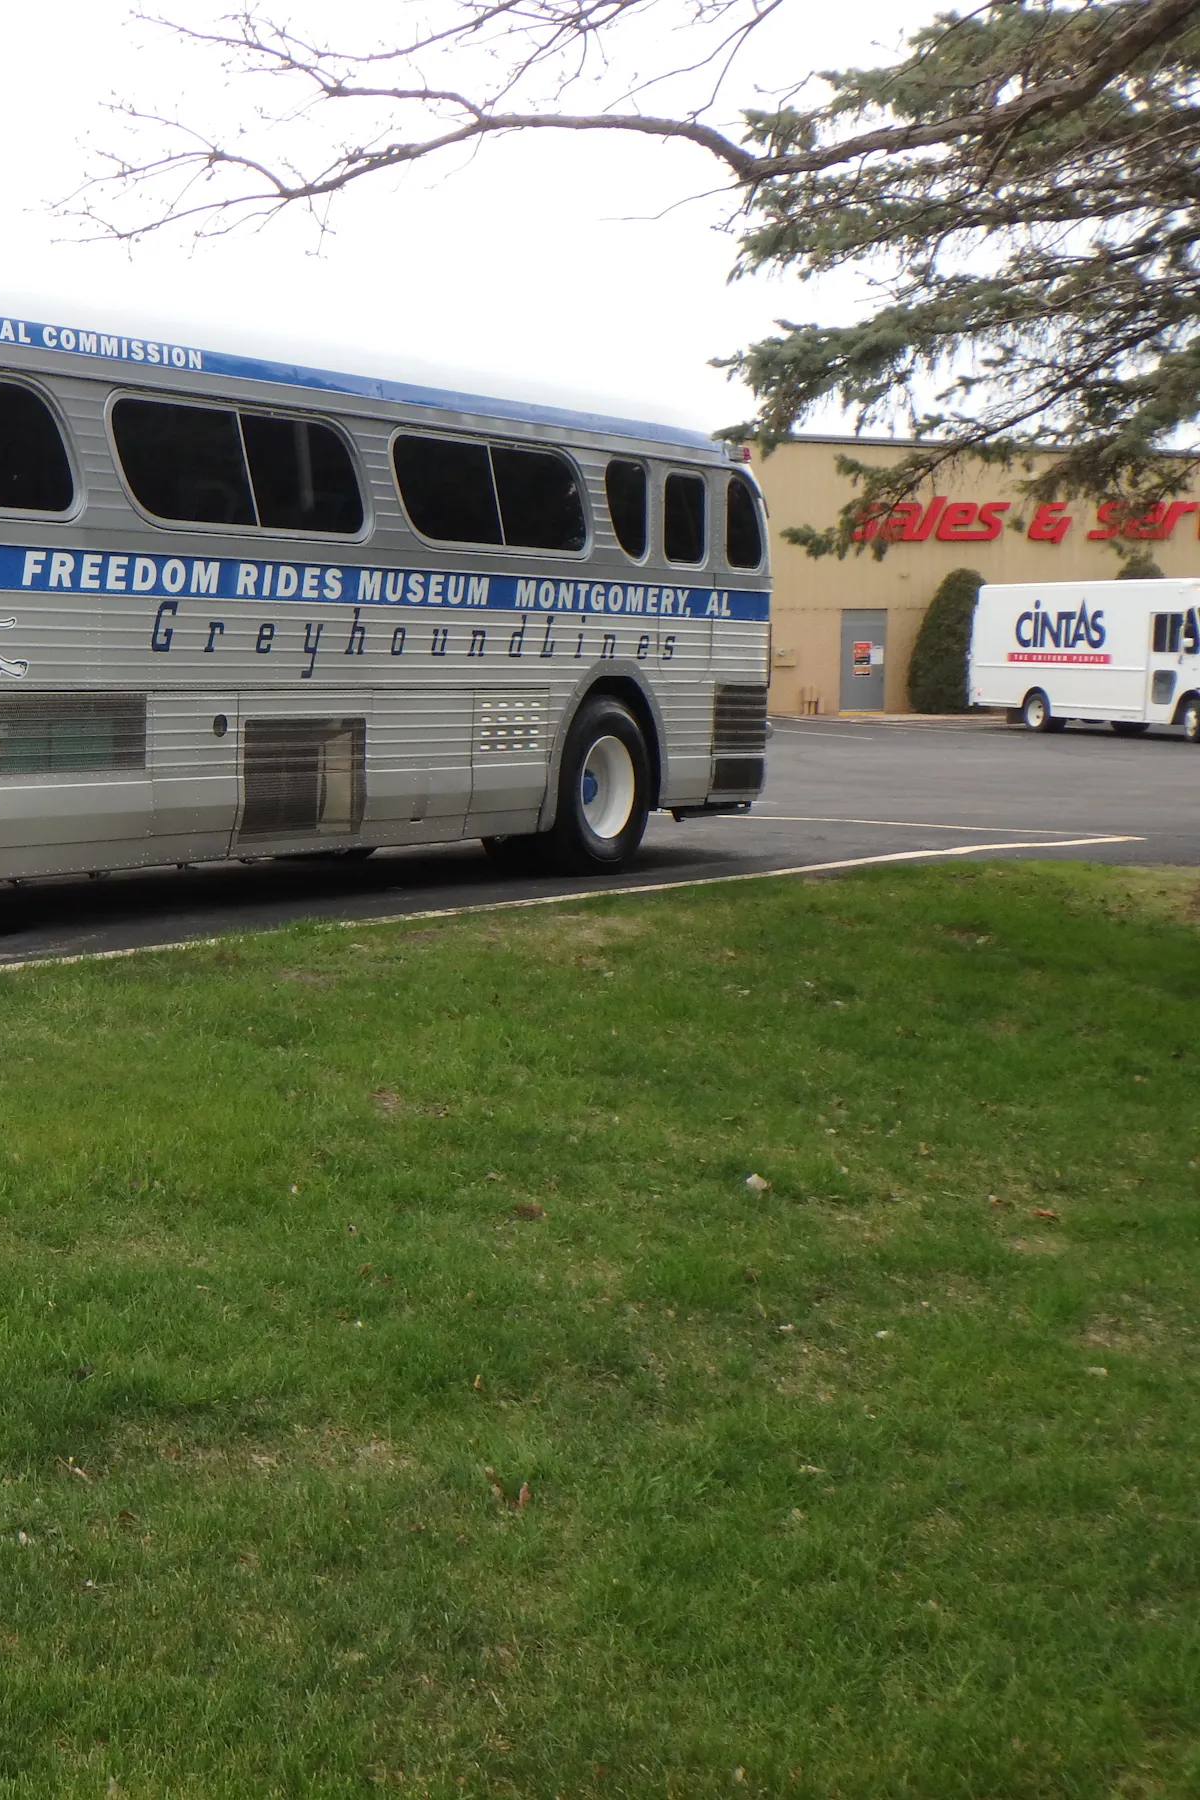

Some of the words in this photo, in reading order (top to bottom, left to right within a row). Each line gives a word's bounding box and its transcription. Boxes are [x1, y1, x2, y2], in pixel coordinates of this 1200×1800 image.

[42, 326, 203, 370] COMMISSION
[1027, 501, 1073, 544] &
[22, 550, 220, 594] FREEDOM
[236, 563, 344, 600] RIDES
[358, 570, 490, 606] MUSEUM
[515, 579, 693, 618] MONTGOMERY,
[705, 598, 731, 617] AL
